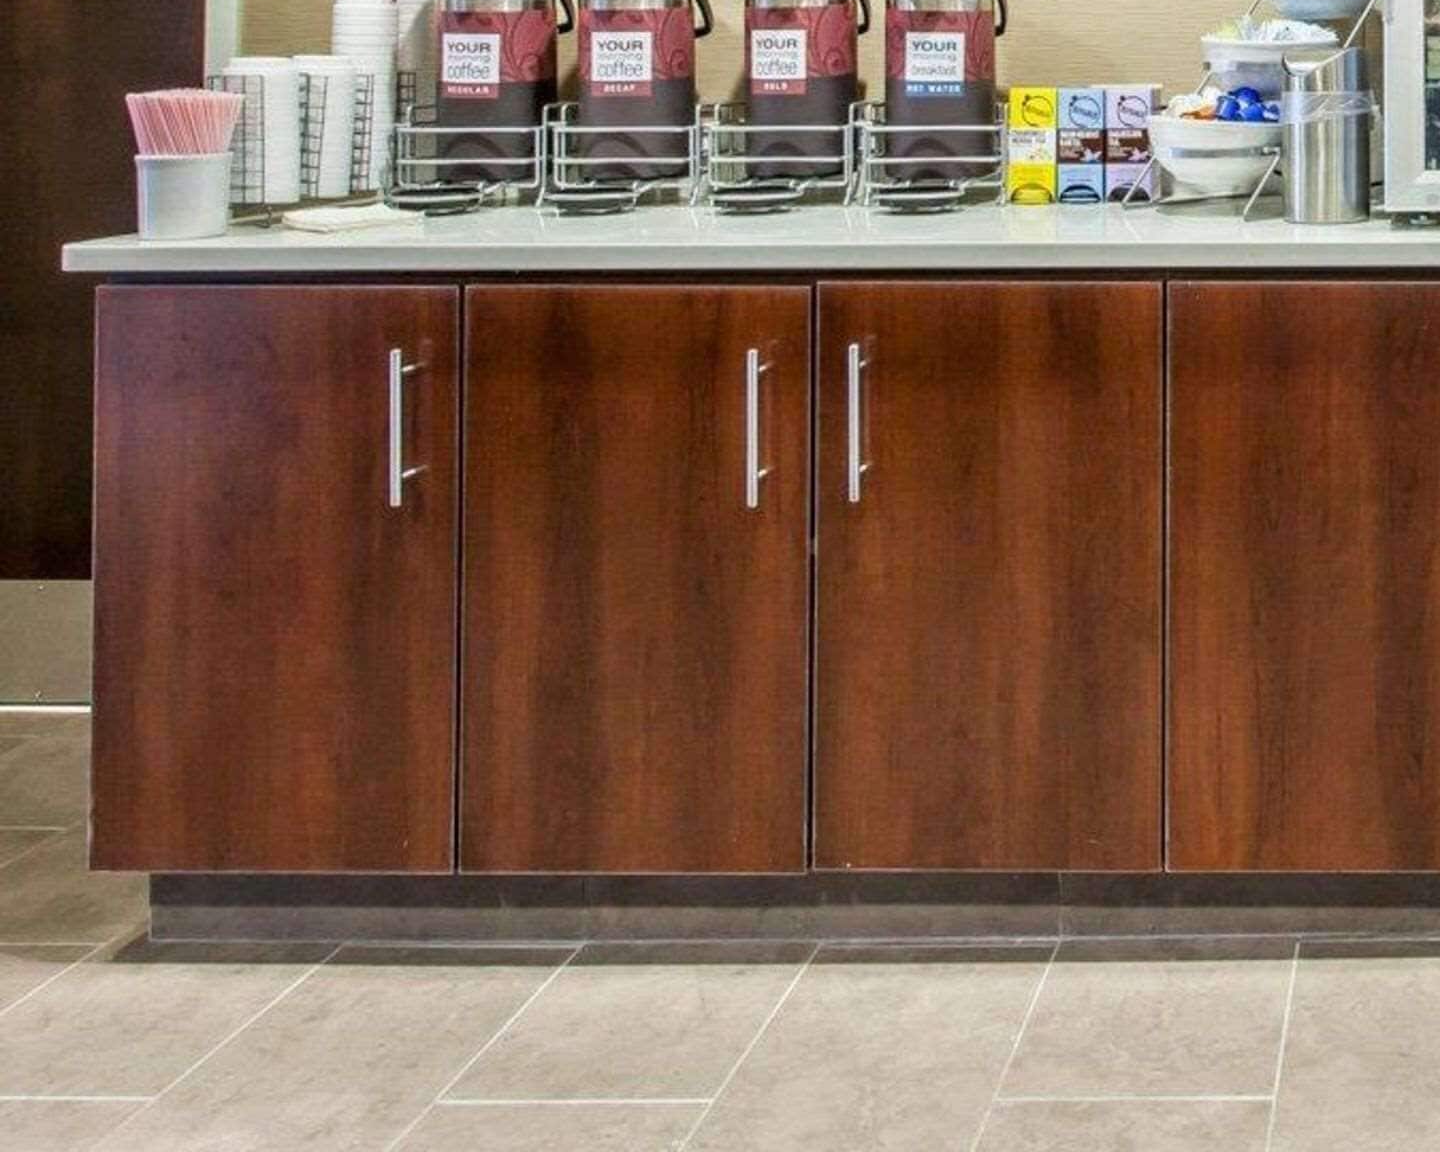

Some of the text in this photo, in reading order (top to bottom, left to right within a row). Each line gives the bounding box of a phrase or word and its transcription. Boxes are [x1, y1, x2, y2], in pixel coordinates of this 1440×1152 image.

[447, 42, 491, 53] YOUR
[597, 40, 643, 51] YOUR
[756, 39, 798, 49] YOUR
[912, 40, 957, 52] YOUR
[447, 62, 490, 79] coffee
[597, 59, 643, 77] coffee
[756, 57, 798, 75] coffee
